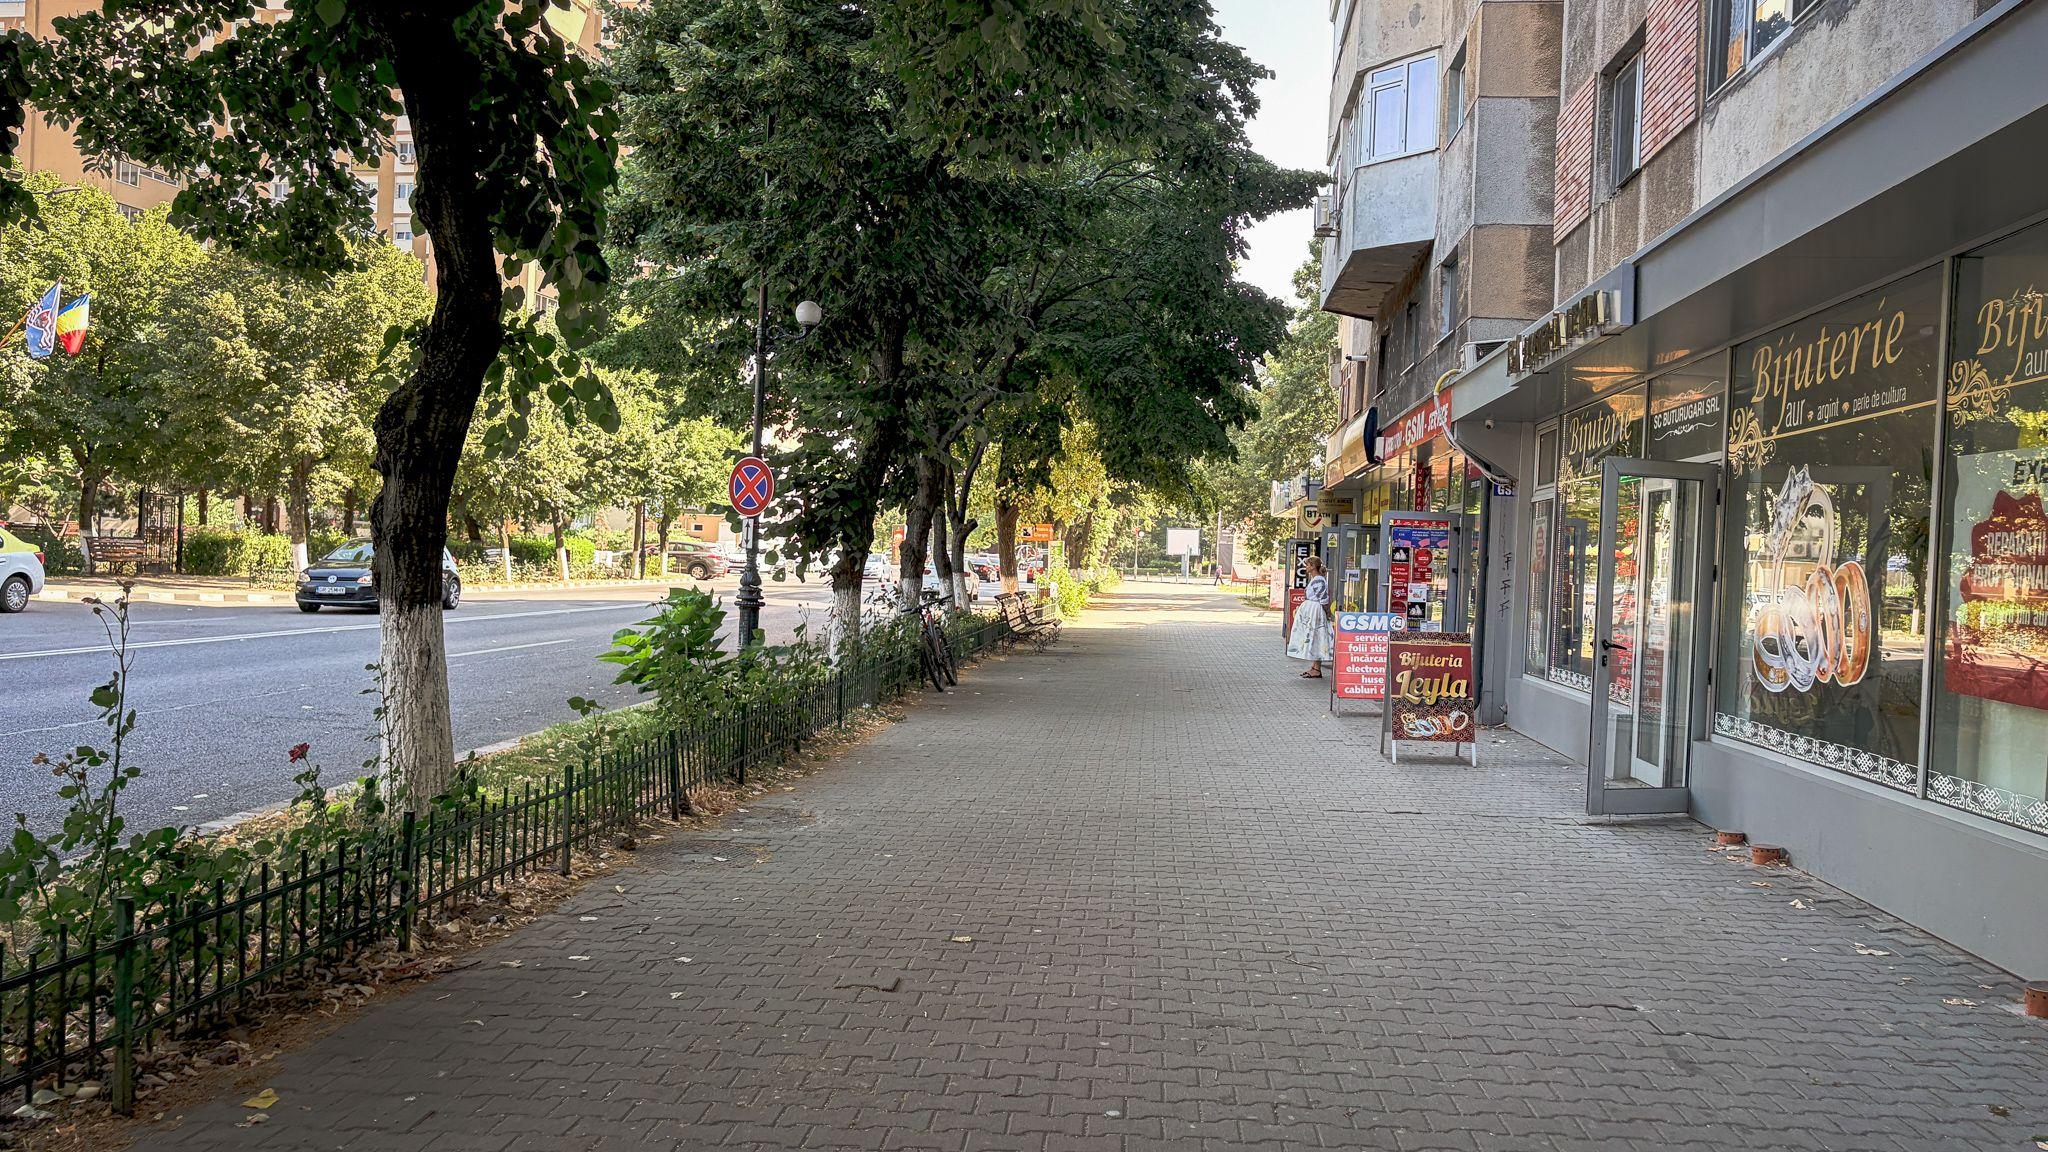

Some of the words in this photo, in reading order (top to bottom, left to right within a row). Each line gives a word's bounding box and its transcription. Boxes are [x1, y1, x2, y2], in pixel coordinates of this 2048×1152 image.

[1977, 284, 2048, 382] Biju
[1751, 297, 1905, 434] Bijuterie
[1653, 414, 1662, 429] SC
[1705, 396, 1720, 414] SRL
[1785, 399, 1805, 427] aur
[1817, 397, 1839, 422] argint
[1853, 393, 1870, 415] perle
[1871, 390, 1880, 407] de
[1881, 386, 1907, 406] cultura
[1405, 410, 1425, 447] GSM
[1569, 408, 1632, 478] Bijuterie
[1306, 510, 1317, 518] BT
[1340, 614, 1388, 631] GSM
[1348, 643, 1368, 652] folii
[1370, 643, 1388, 652] stic
[1355, 634, 1388, 642] service
[1399, 651, 1463, 670] Bijuteria
[1344, 685, 1377, 694] cabluri
[1361, 675, 1384, 684] huse
[1396, 670, 1468, 706] Leyla
